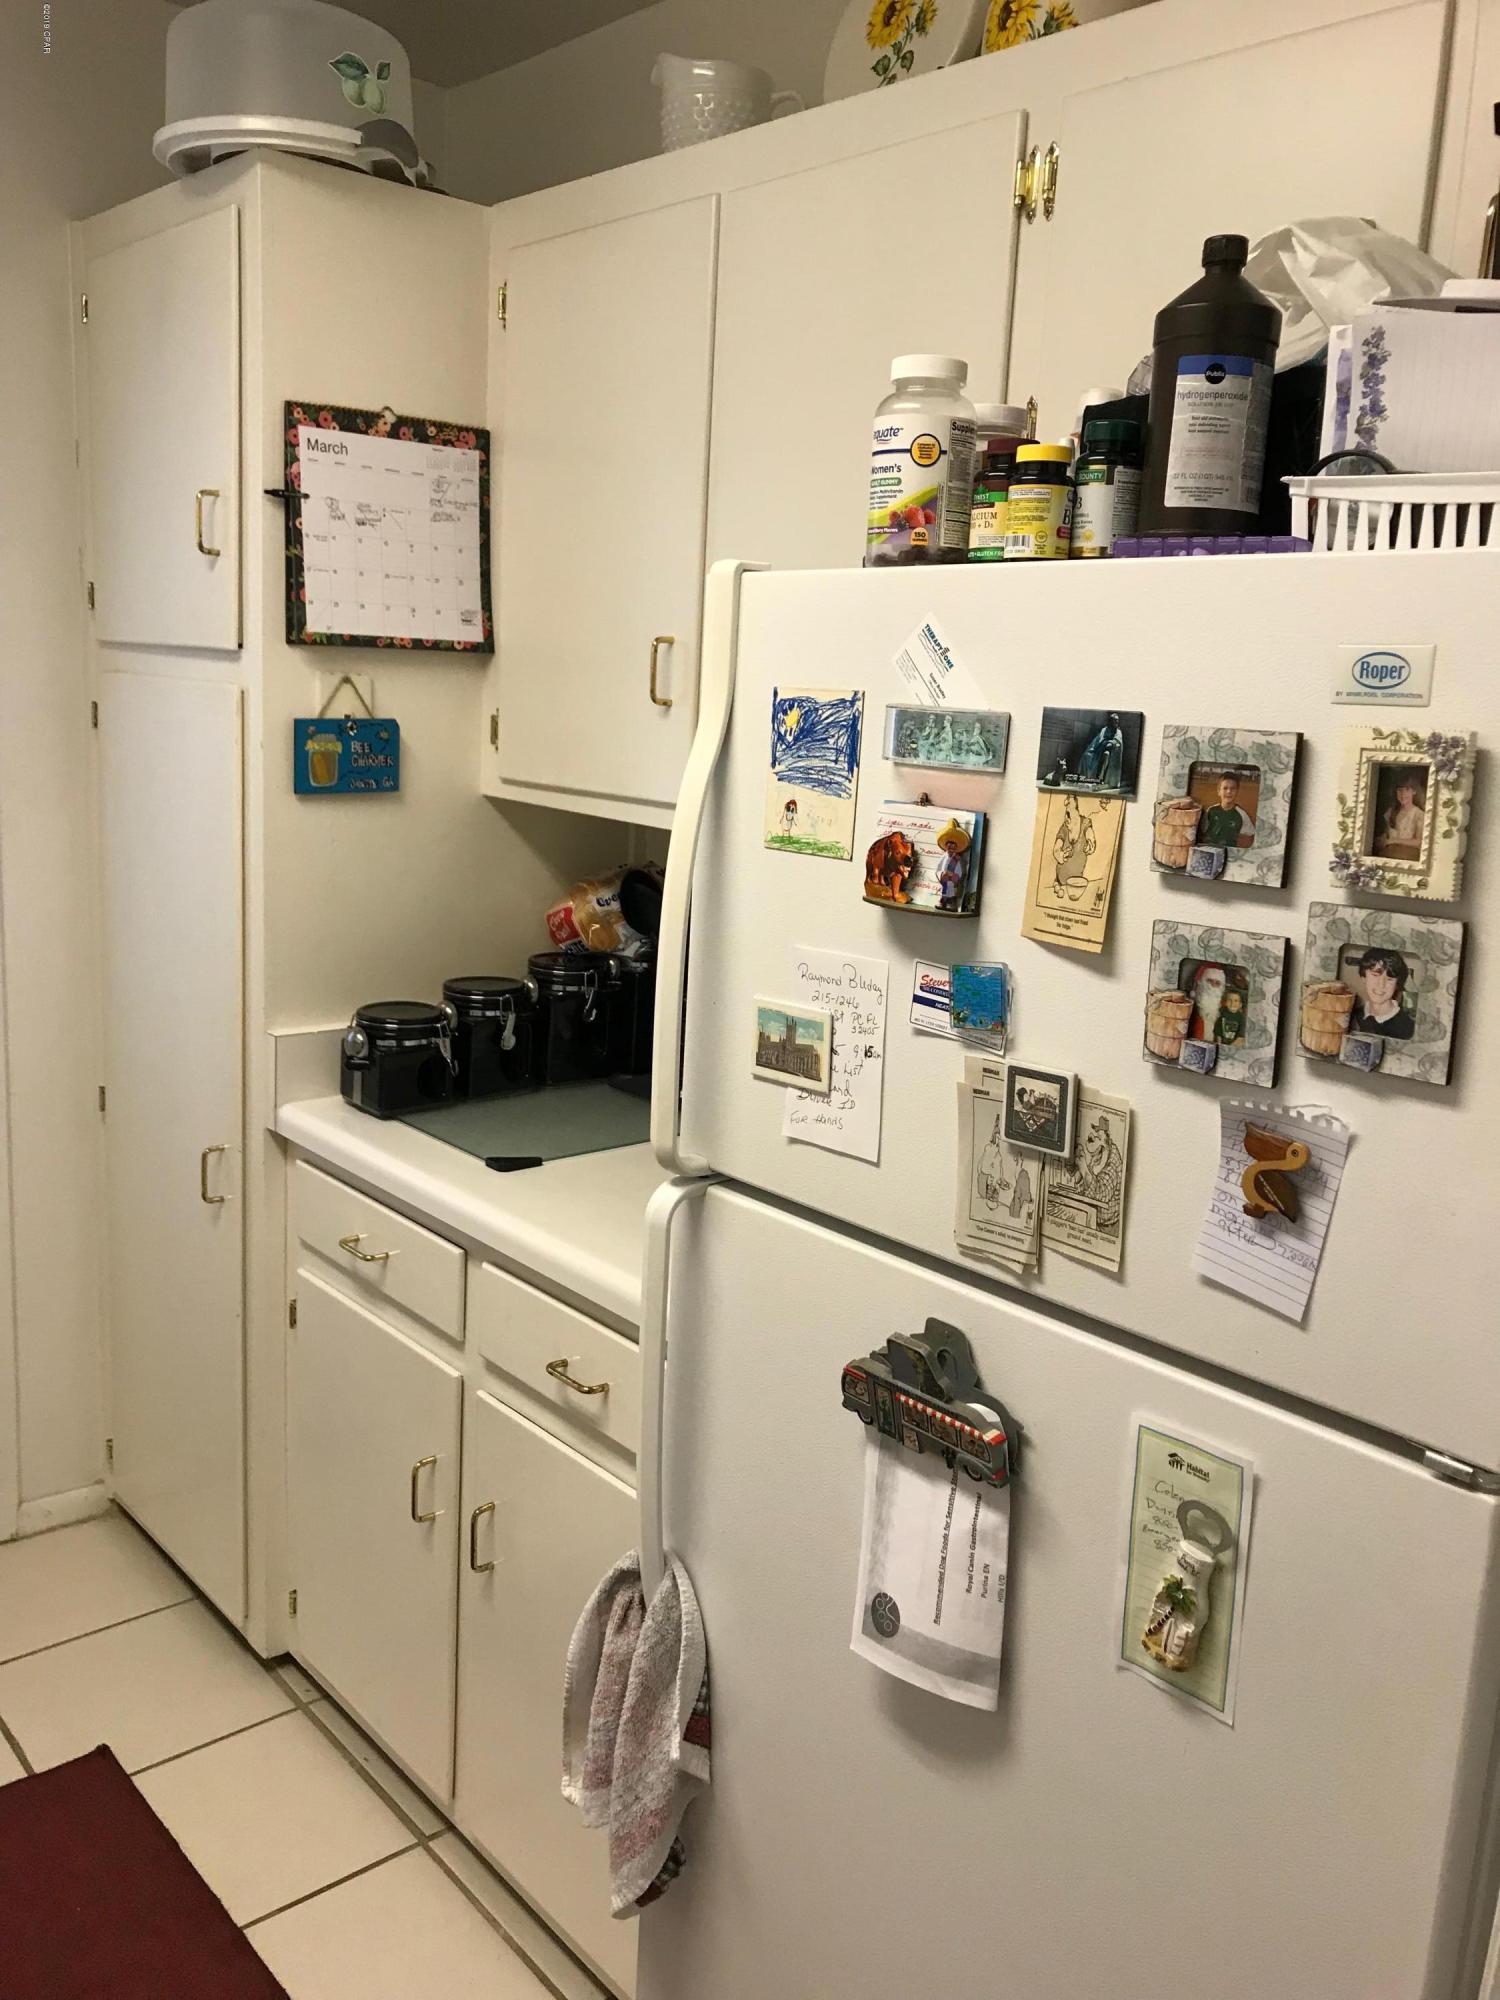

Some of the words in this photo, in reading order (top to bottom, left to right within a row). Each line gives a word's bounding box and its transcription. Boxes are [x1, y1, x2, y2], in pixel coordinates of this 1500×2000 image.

[306, 437, 349, 456] March
[924, 623, 943, 651] THERAPY
[1360, 661, 1406, 682] Roper
[798, 962, 842, 987] Raymond
[1186, 1462, 1210, 1478] Habitat
[945, 1487, 956, 1524] Sensitive
[941, 1534, 950, 1554] Foods
[938, 1554, 947, 1570] Dog
[967, 1551, 976, 1574] Canin
[983, 1563, 991, 1574] EN
[966, 1574, 975, 1594] Royal
[981, 1575, 989, 1599] Purina
[934, 1570, 945, 1627] Recommended
